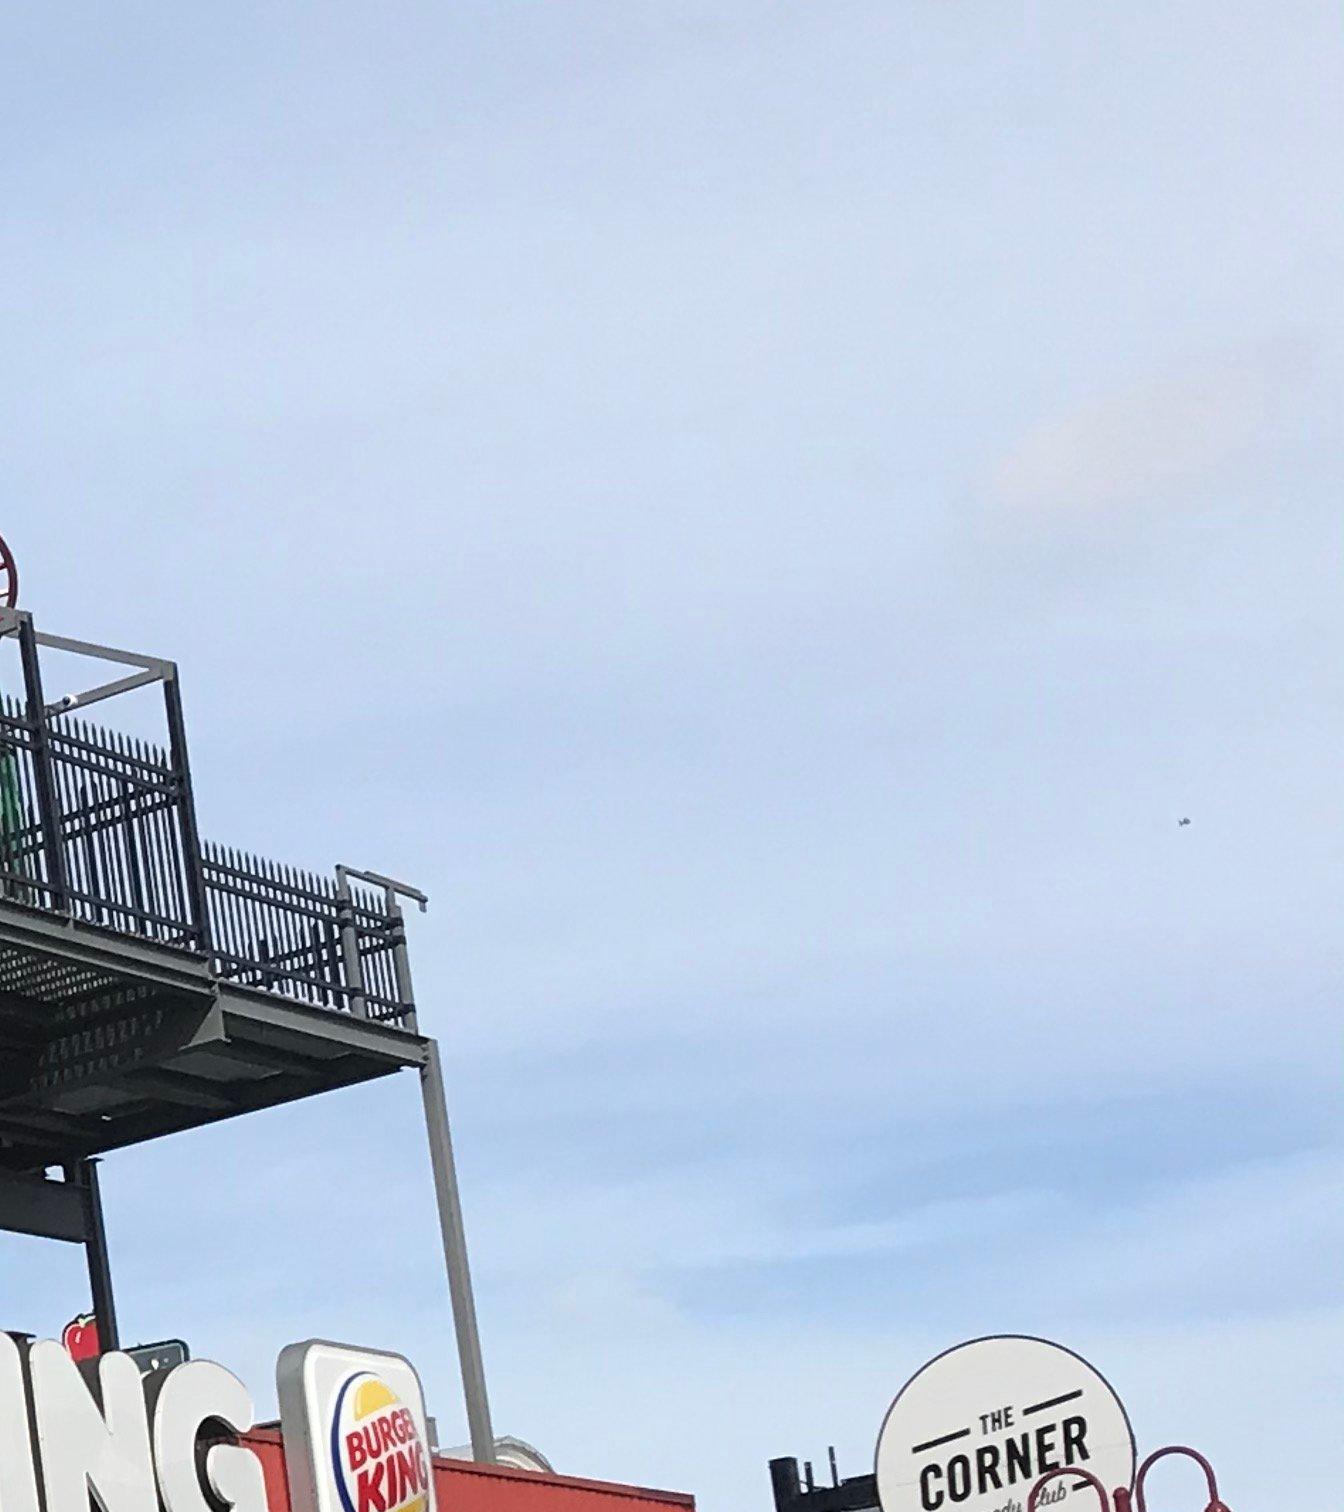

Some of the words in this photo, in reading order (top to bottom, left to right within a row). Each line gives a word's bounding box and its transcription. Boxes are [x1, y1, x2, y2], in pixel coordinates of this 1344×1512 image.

[979, 1405, 1015, 1435] THE
[920, 1415, 1091, 1512] CORNER
[1035, 1480, 1067, 1508] lub
